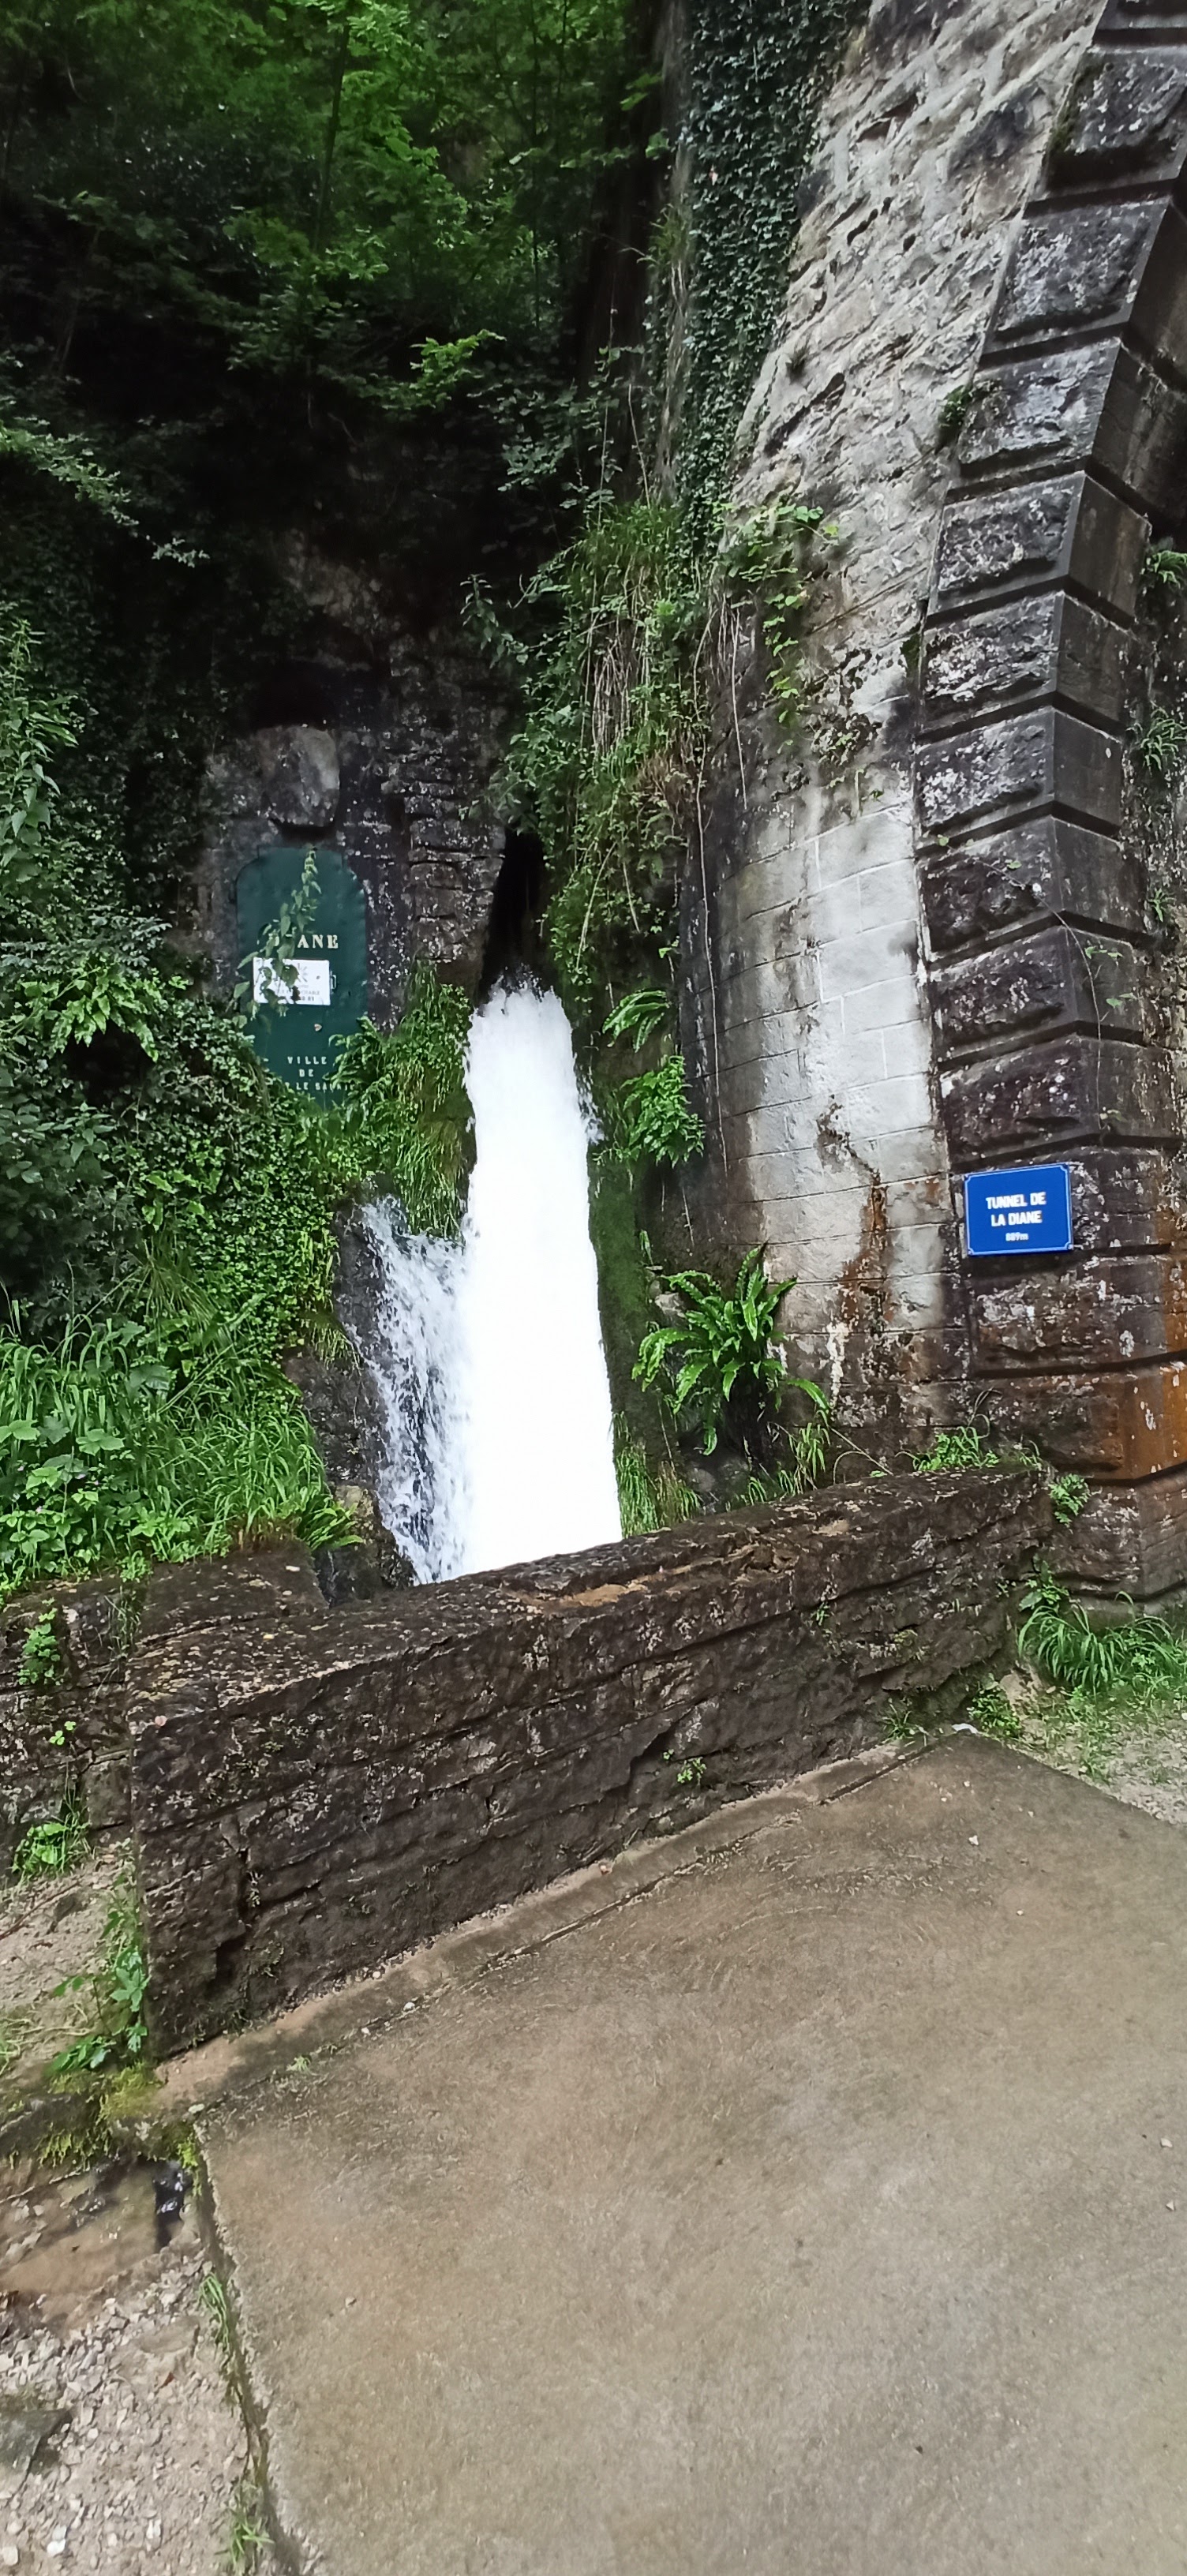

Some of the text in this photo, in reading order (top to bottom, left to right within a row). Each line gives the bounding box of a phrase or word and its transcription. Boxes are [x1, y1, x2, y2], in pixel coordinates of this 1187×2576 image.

[287, 1056, 327, 1065] VILLE
[299, 1069, 313, 1077] DE
[986, 1192, 1047, 1209] TUNNEL DE
[991, 1210, 1043, 1227] LA DIANE
